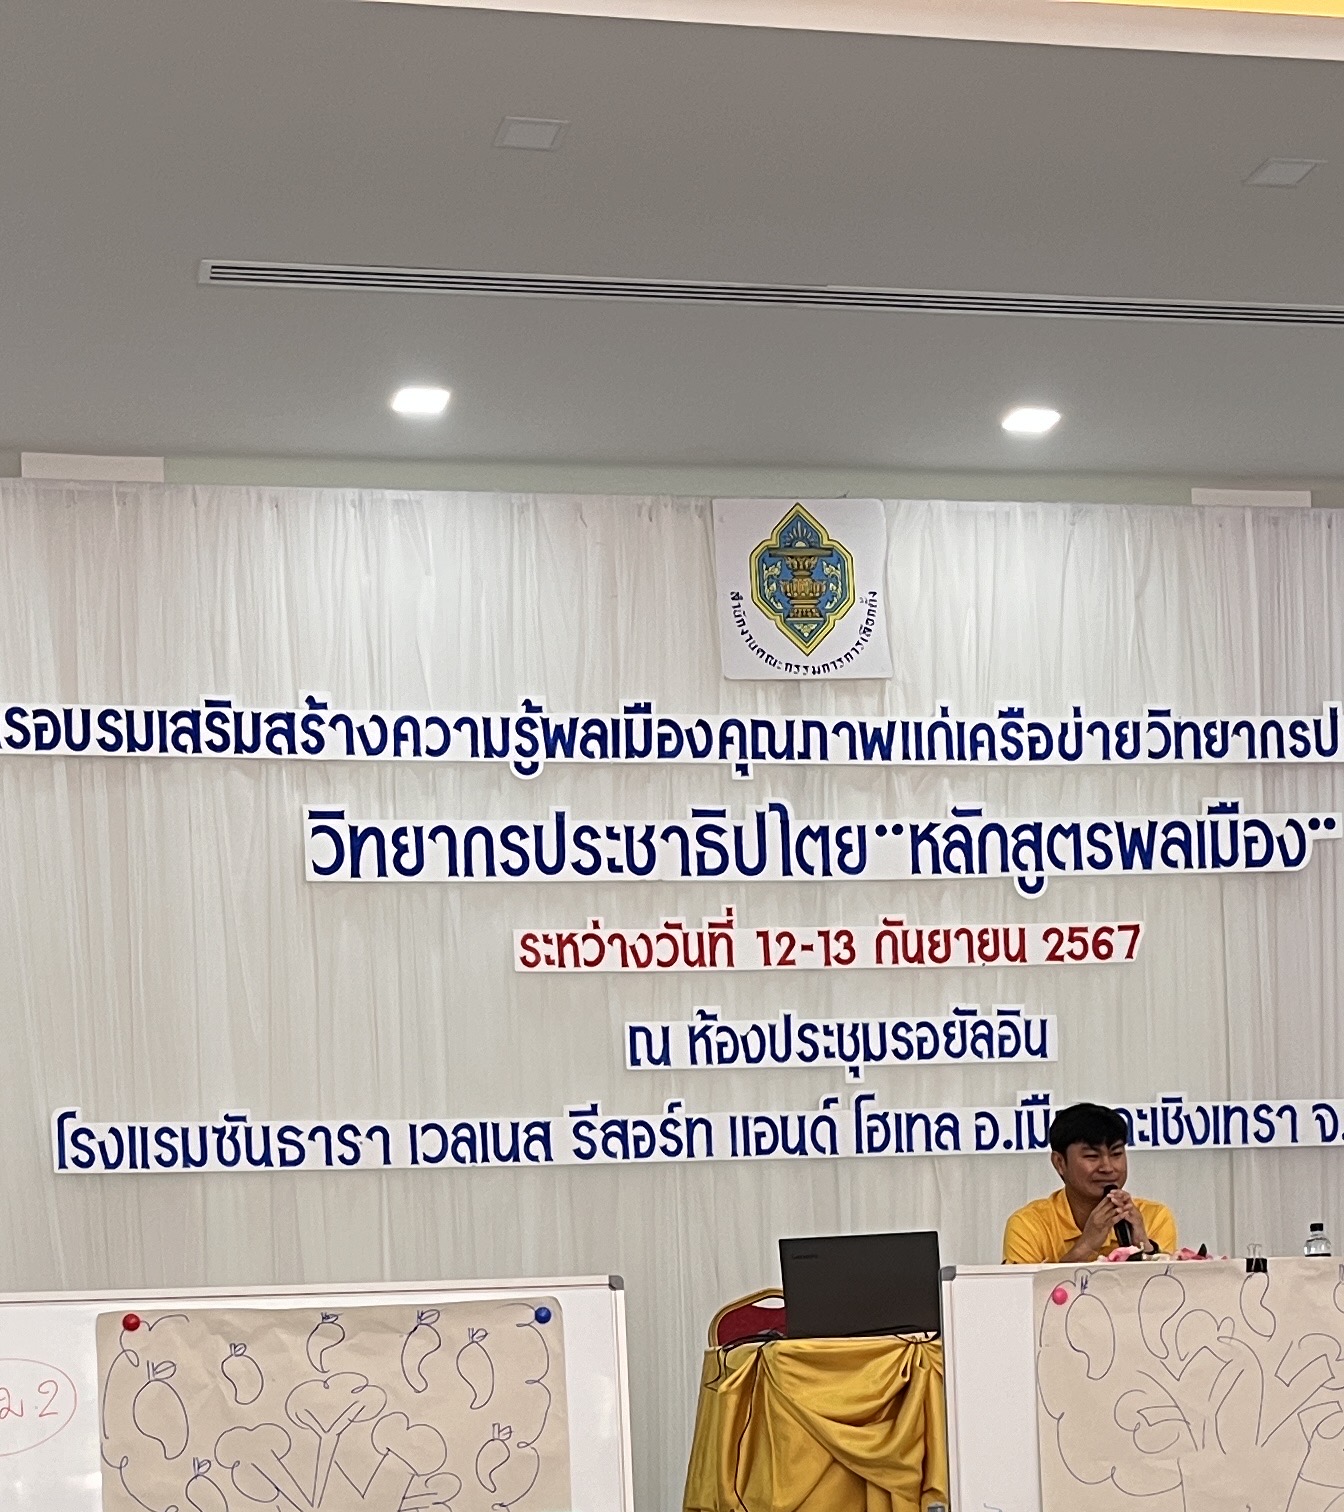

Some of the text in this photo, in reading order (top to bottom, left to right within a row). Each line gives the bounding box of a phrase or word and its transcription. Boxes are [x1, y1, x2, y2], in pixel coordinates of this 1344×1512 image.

[520, 908, 1141, 969] ระหว่างวันที่ 12-13 กันยายน 2567
[628, 1008, 1049, 1079] ณ ห้องประชุมรอยัลอิน
[57, 1113, 392, 1170] โรงแรมซันธารา
[408, 1119, 554, 1165] เวลเนส
[568, 1104, 714, 1161] รีสอร์ท
[729, 1099, 840, 1157] แอนด์
[854, 1096, 961, 1155] โฮเทล
[37, 1379, 59, 1418] 2
